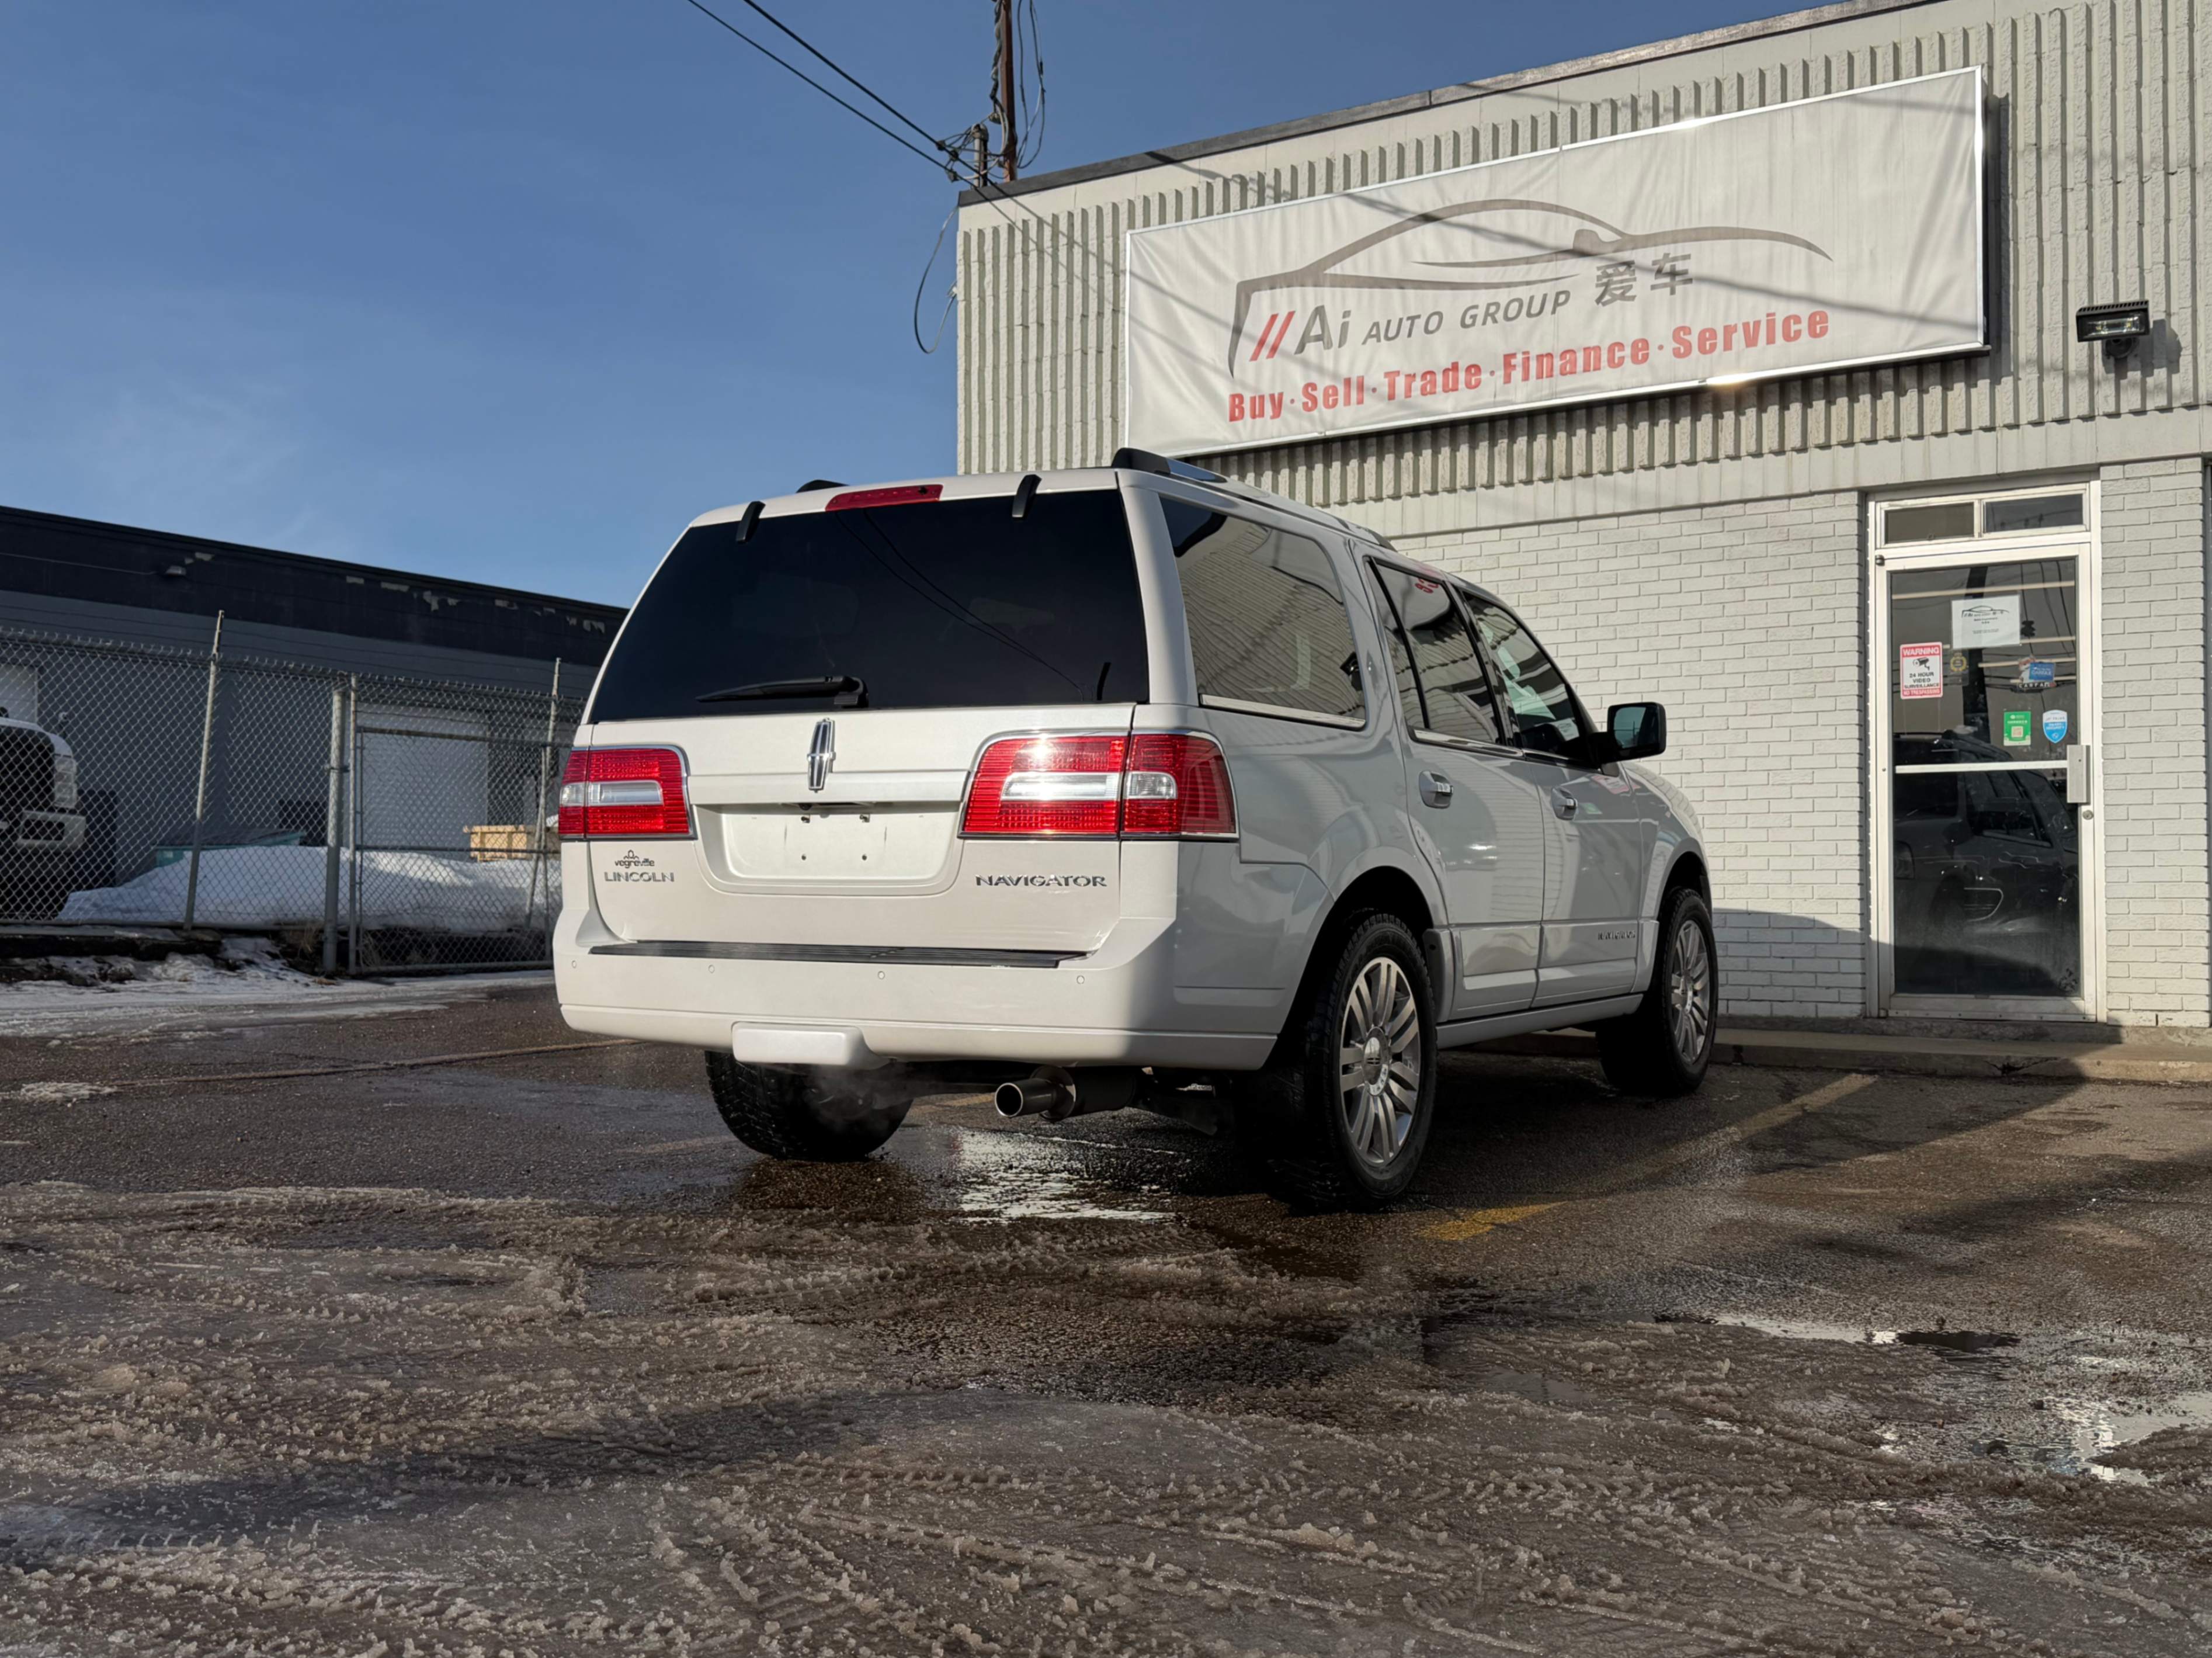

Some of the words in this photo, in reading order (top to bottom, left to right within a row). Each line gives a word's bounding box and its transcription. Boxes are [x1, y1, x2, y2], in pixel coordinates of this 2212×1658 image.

[1595, 252, 1693, 307] 爱车
[1361, 311, 1444, 345] AUTO
[1460, 290, 1571, 329] GROUP
[1229, 392, 1284, 422] Buy
[1301, 376, 1364, 412] Sell
[1384, 361, 1482, 401] Trade
[1503, 338, 1650, 384] Finance
[1672, 310, 1828, 359] Service
[1903, 647, 1939, 655] WARNING
[604, 872, 675, 882] LINCOLN
[975, 875, 1107, 887] NAVIGATOR
